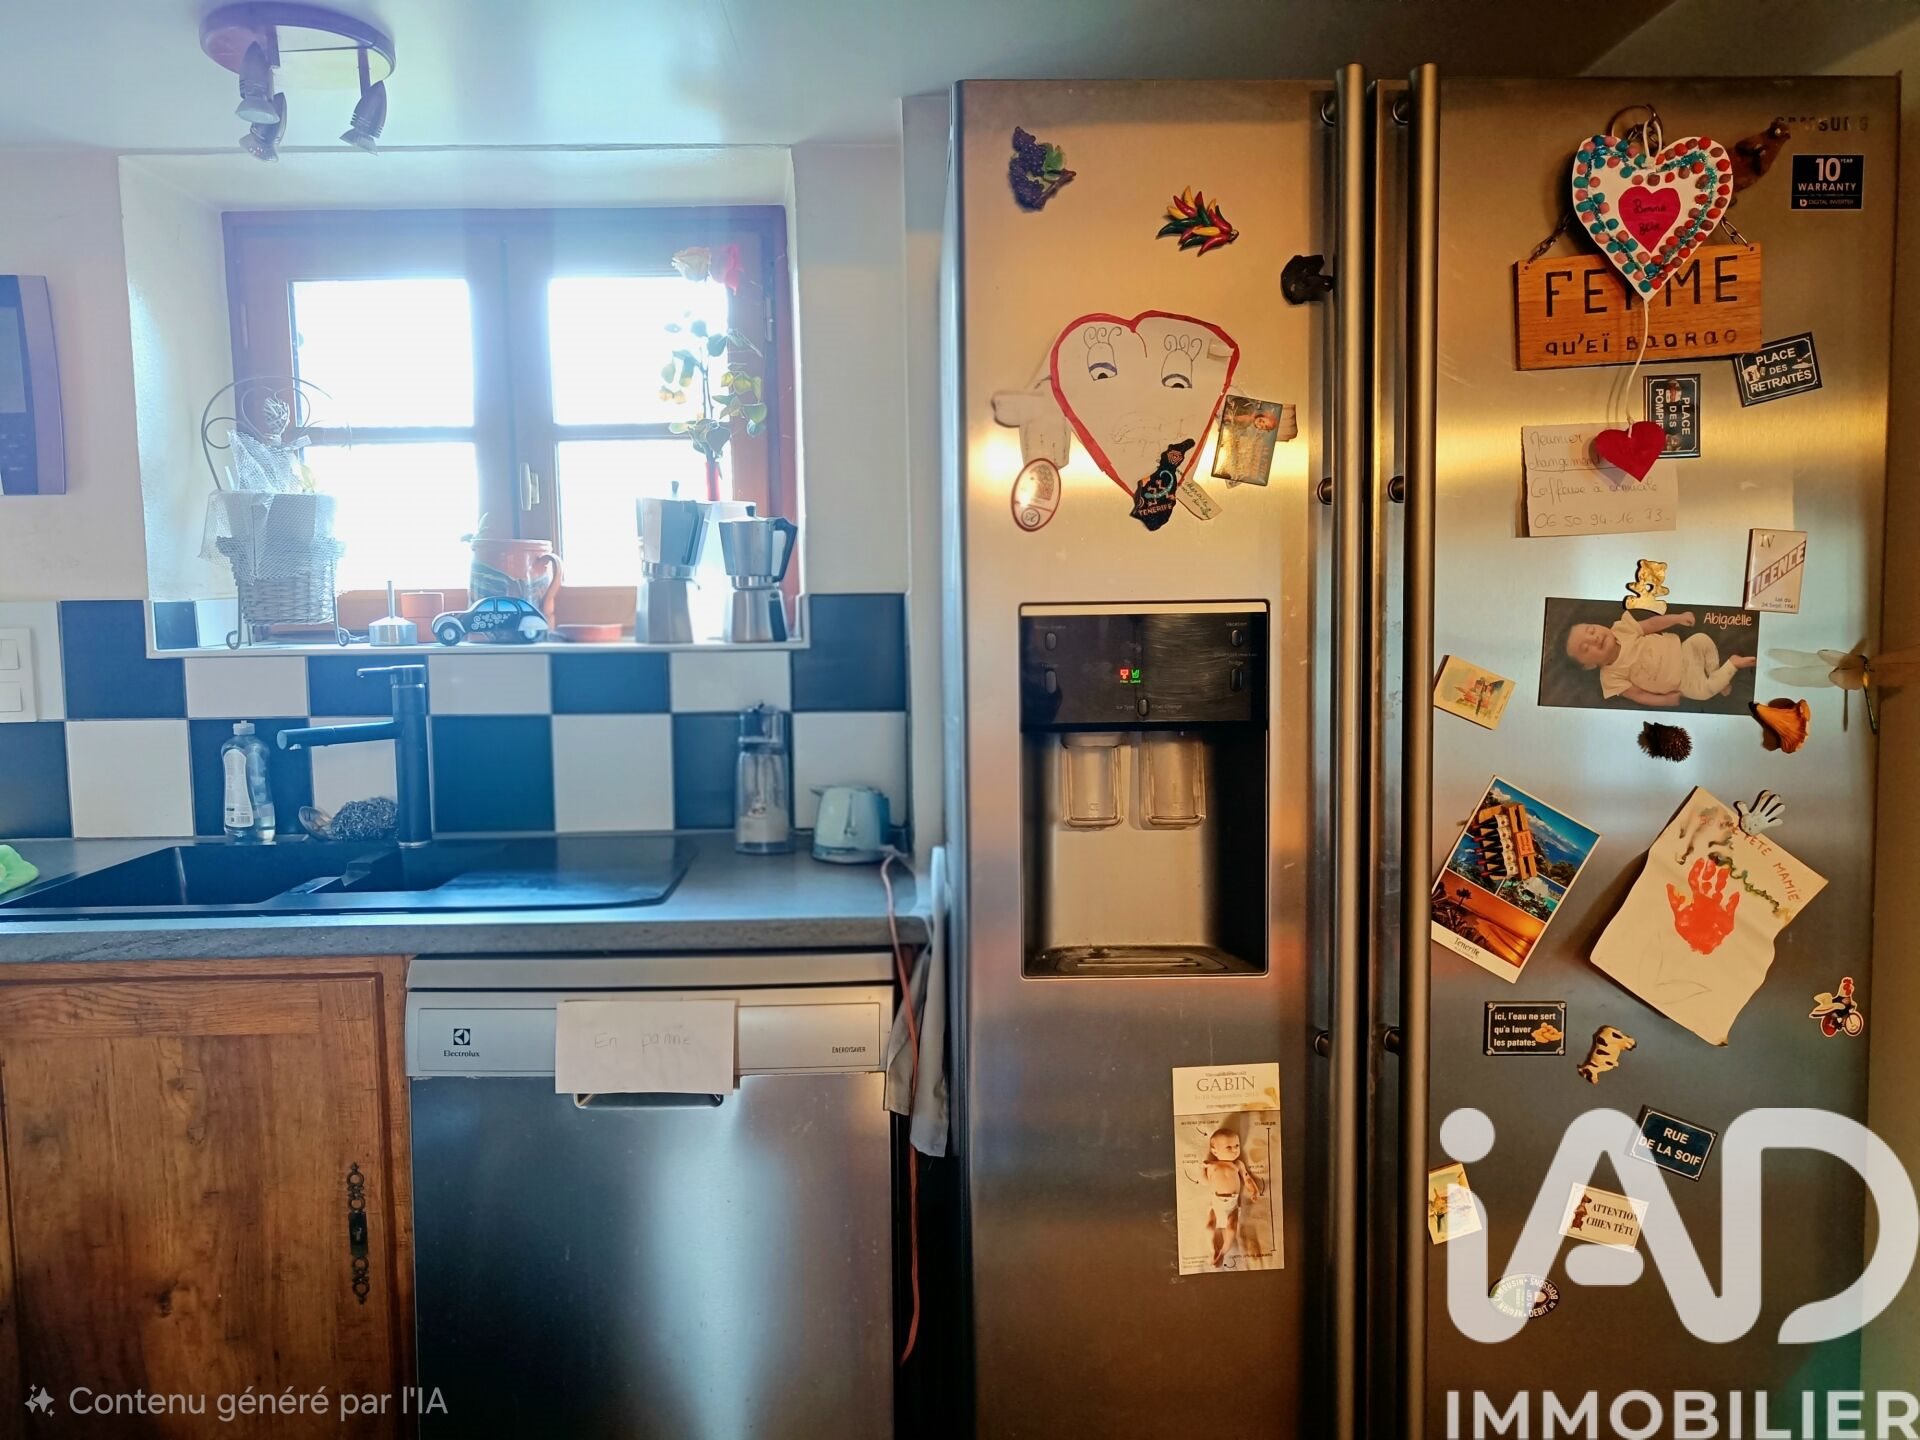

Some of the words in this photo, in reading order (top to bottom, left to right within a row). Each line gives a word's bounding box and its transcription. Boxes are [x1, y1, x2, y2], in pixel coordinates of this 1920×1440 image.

[1815, 157, 1841, 181] 10
[1797, 183, 1857, 191] WARRANTY
[1545, 254, 1738, 318] FEME
[1755, 347, 1797, 366] PLACE
[1769, 364, 1788, 375] DES
[1750, 369, 1812, 394] RETRAITÉS
[1669, 405, 1677, 428] DES
[1681, 397, 1691, 435] PLACE
[1138, 503, 1173, 516] TENERIFE
[1533, 511, 1557, 529] 06
[1564, 513, 1582, 526] 50
[1760, 534, 1776, 549] IV
[1703, 612, 1752, 630] Abigaëlle
[1494, 1011, 1507, 1021] ici,
[1508, 1011, 1527, 1020] l'eau
[1540, 1012, 1556, 1020] sert
[1494, 1025, 1510, 1036] qu'a
[1512, 1025, 1532, 1033] laver
[594, 1032, 617, 1048] En
[1494, 1038, 1506, 1047] les
[1507, 1039, 1537, 1048] patates
[1196, 1075, 1256, 1092] GABIN
[1663, 1127, 1690, 1145] RUE
[1638, 1135, 1656, 1150] DE
[1656, 1143, 1672, 1157] LA
[1674, 1149, 1702, 1166] SOIF
[1586, 1216, 1611, 1231] CHIEN
[1613, 1222, 1635, 1236] TÊTU
